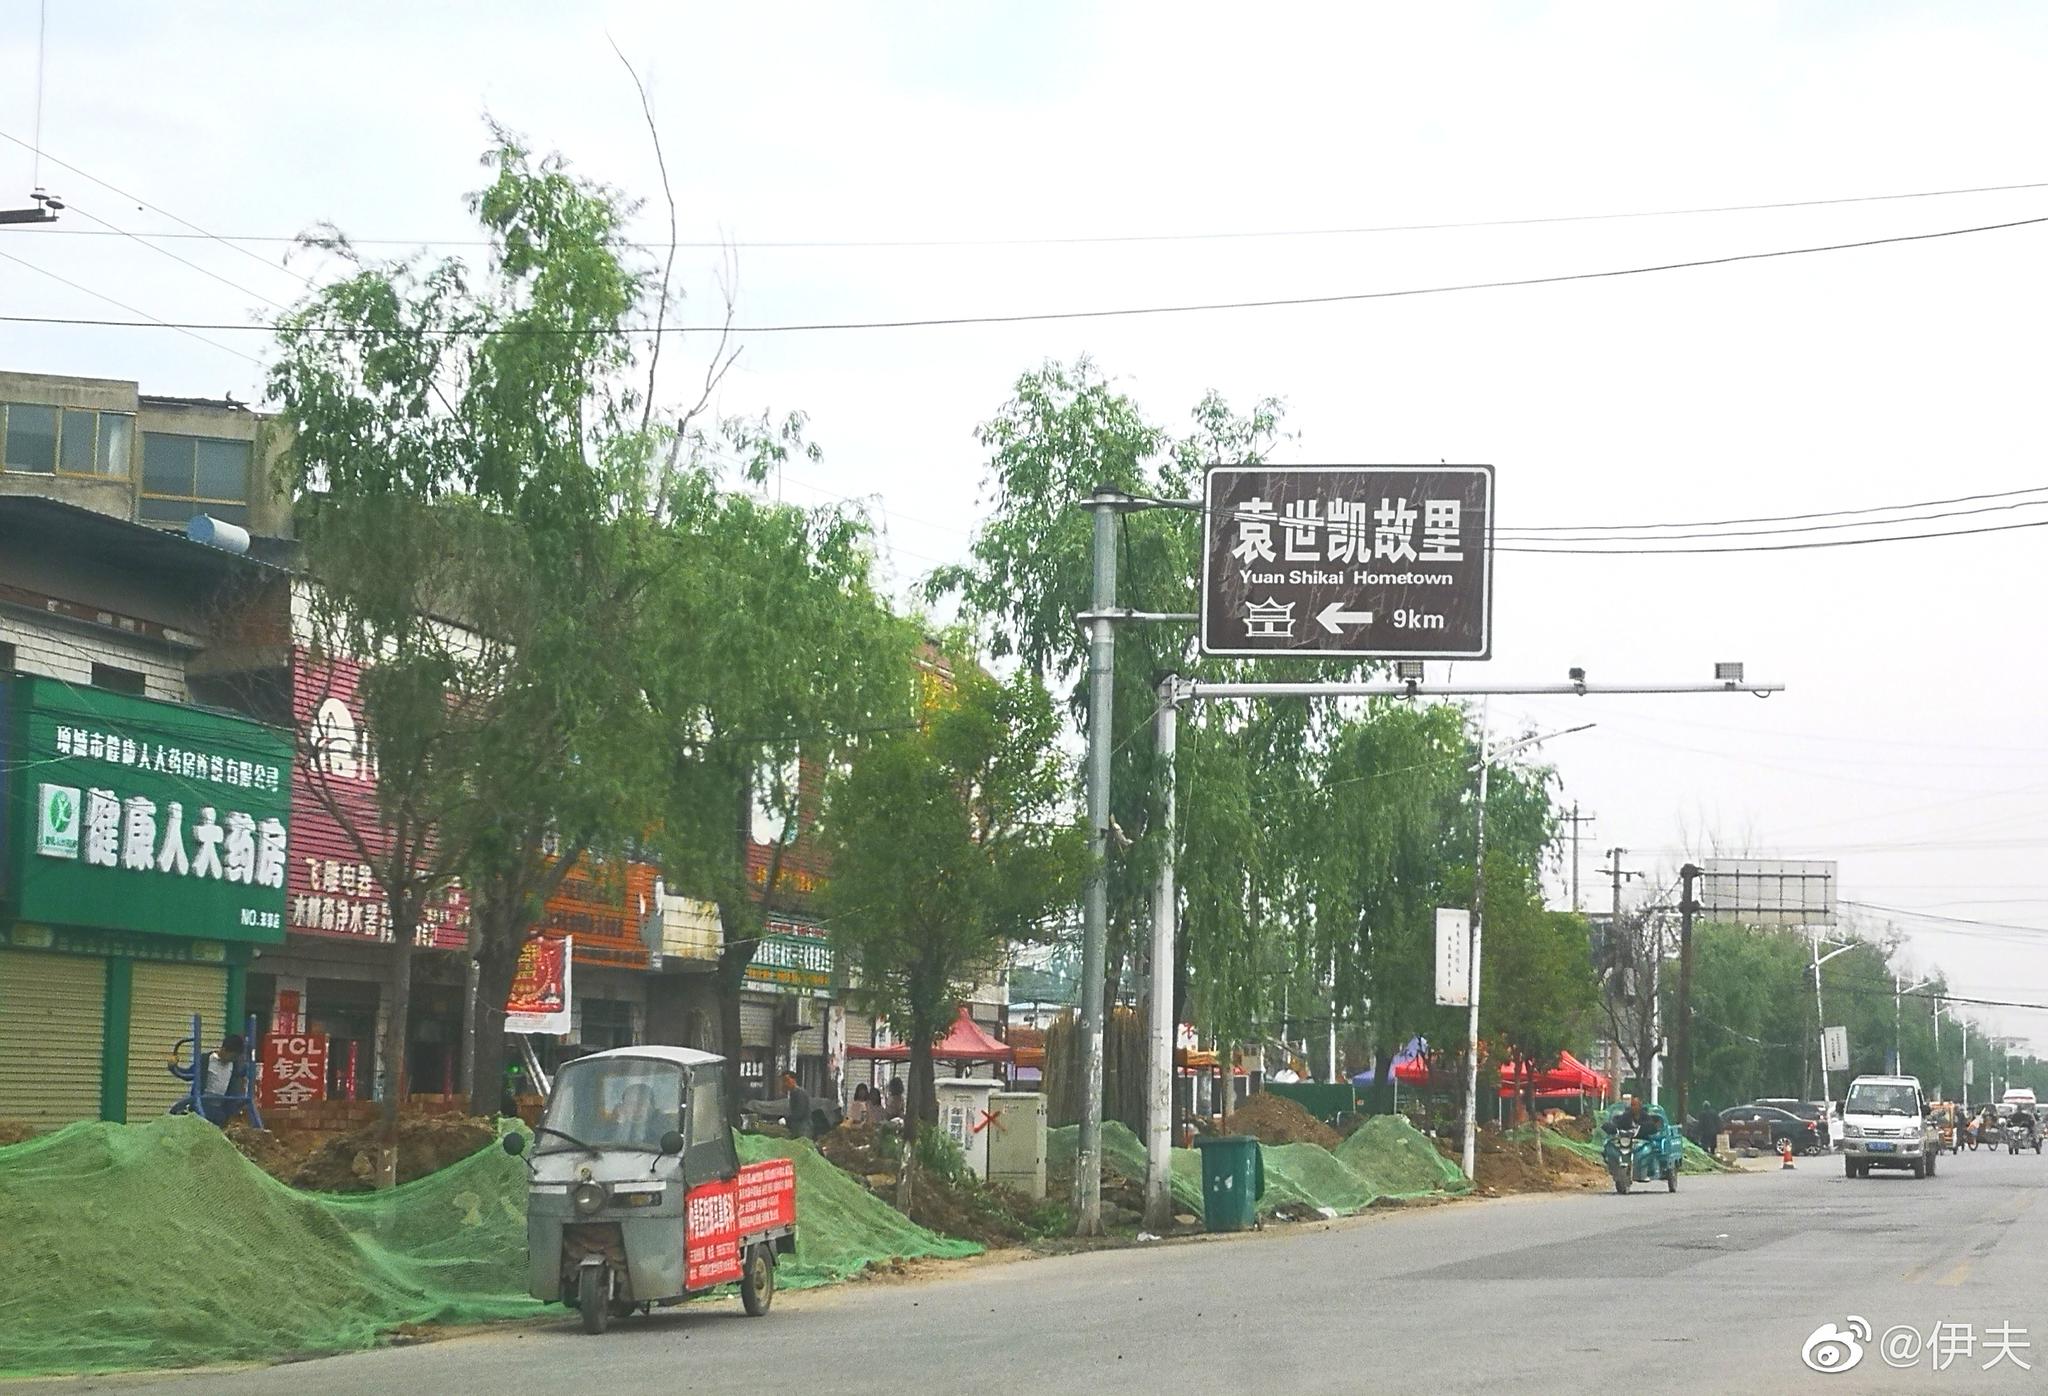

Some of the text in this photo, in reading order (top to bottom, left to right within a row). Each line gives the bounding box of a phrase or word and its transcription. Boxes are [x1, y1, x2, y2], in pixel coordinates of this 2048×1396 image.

[1232, 498, 1464, 564] 袁世凯故里
[1240, 570, 1453, 584] Yuan Shikai Hometown
[1393, 609, 1444, 629] 9km
[85, 787, 287, 888] 健康人大药房
[272, 1038, 322, 1055] TCL
